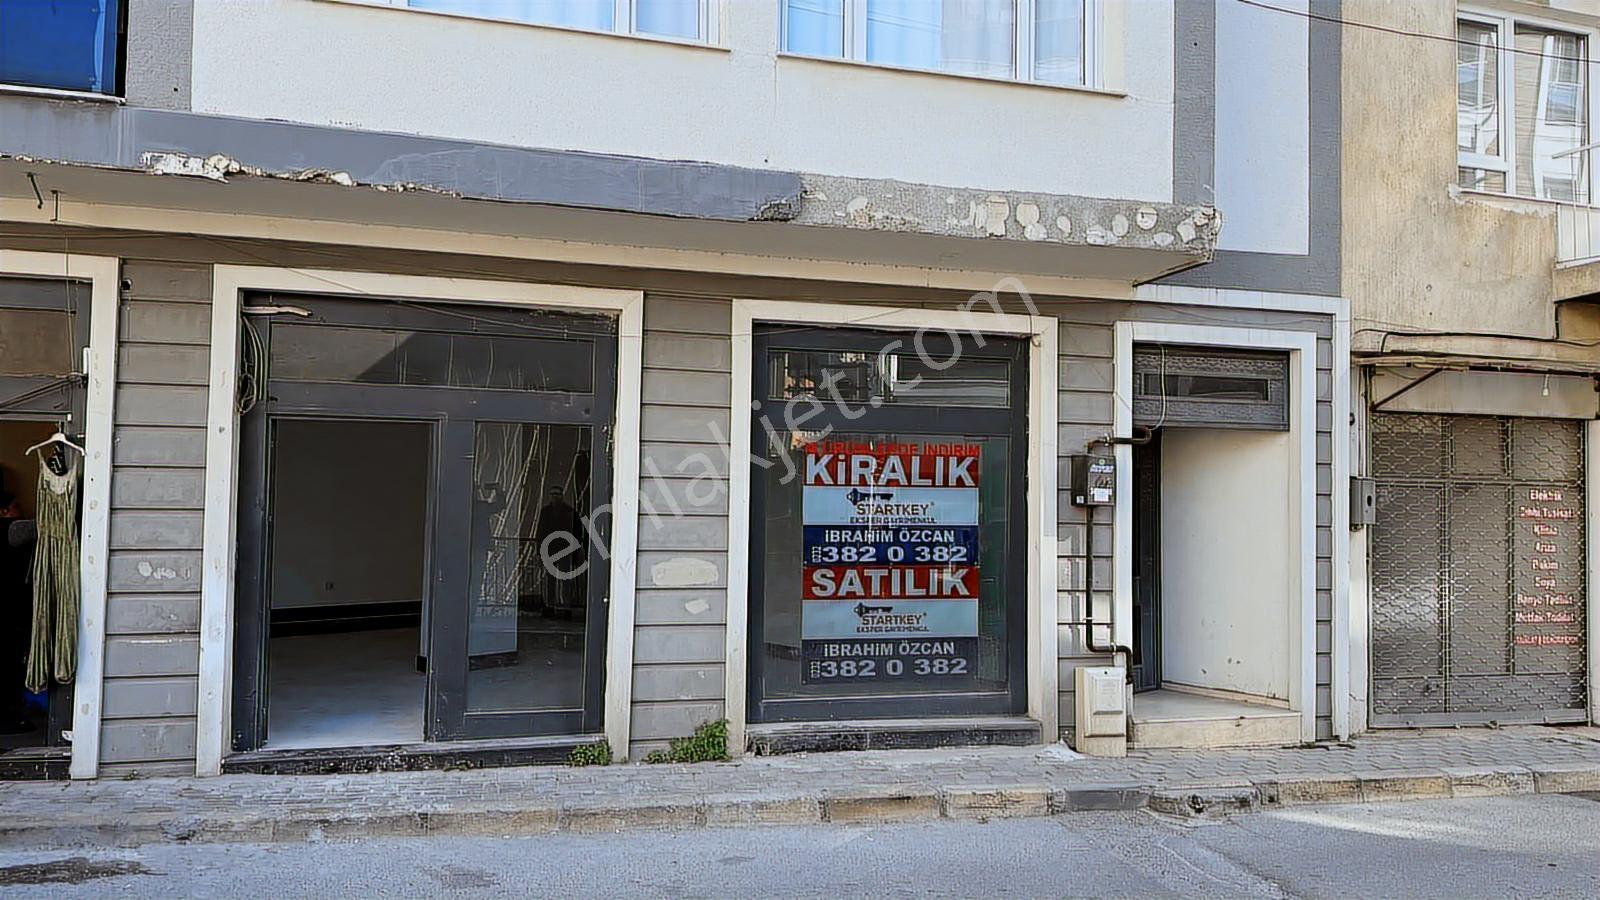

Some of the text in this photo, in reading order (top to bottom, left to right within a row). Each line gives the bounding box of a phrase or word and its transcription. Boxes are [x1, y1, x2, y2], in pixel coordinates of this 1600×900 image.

[856, 503, 929, 516] STARTKEY
[899, 527, 955, 543] ÖZCAN
[822, 545, 876, 562] 382
[887, 545, 904, 562] 0
[915, 545, 967, 562] 382
[811, 568, 970, 597] SATILIK
[862, 614, 923, 626] STARTKEY
[900, 641, 955, 656] ÖZCAN
[821, 659, 876, 678] 382
[886, 658, 904, 676] 0
[914, 657, 967, 675] 382
